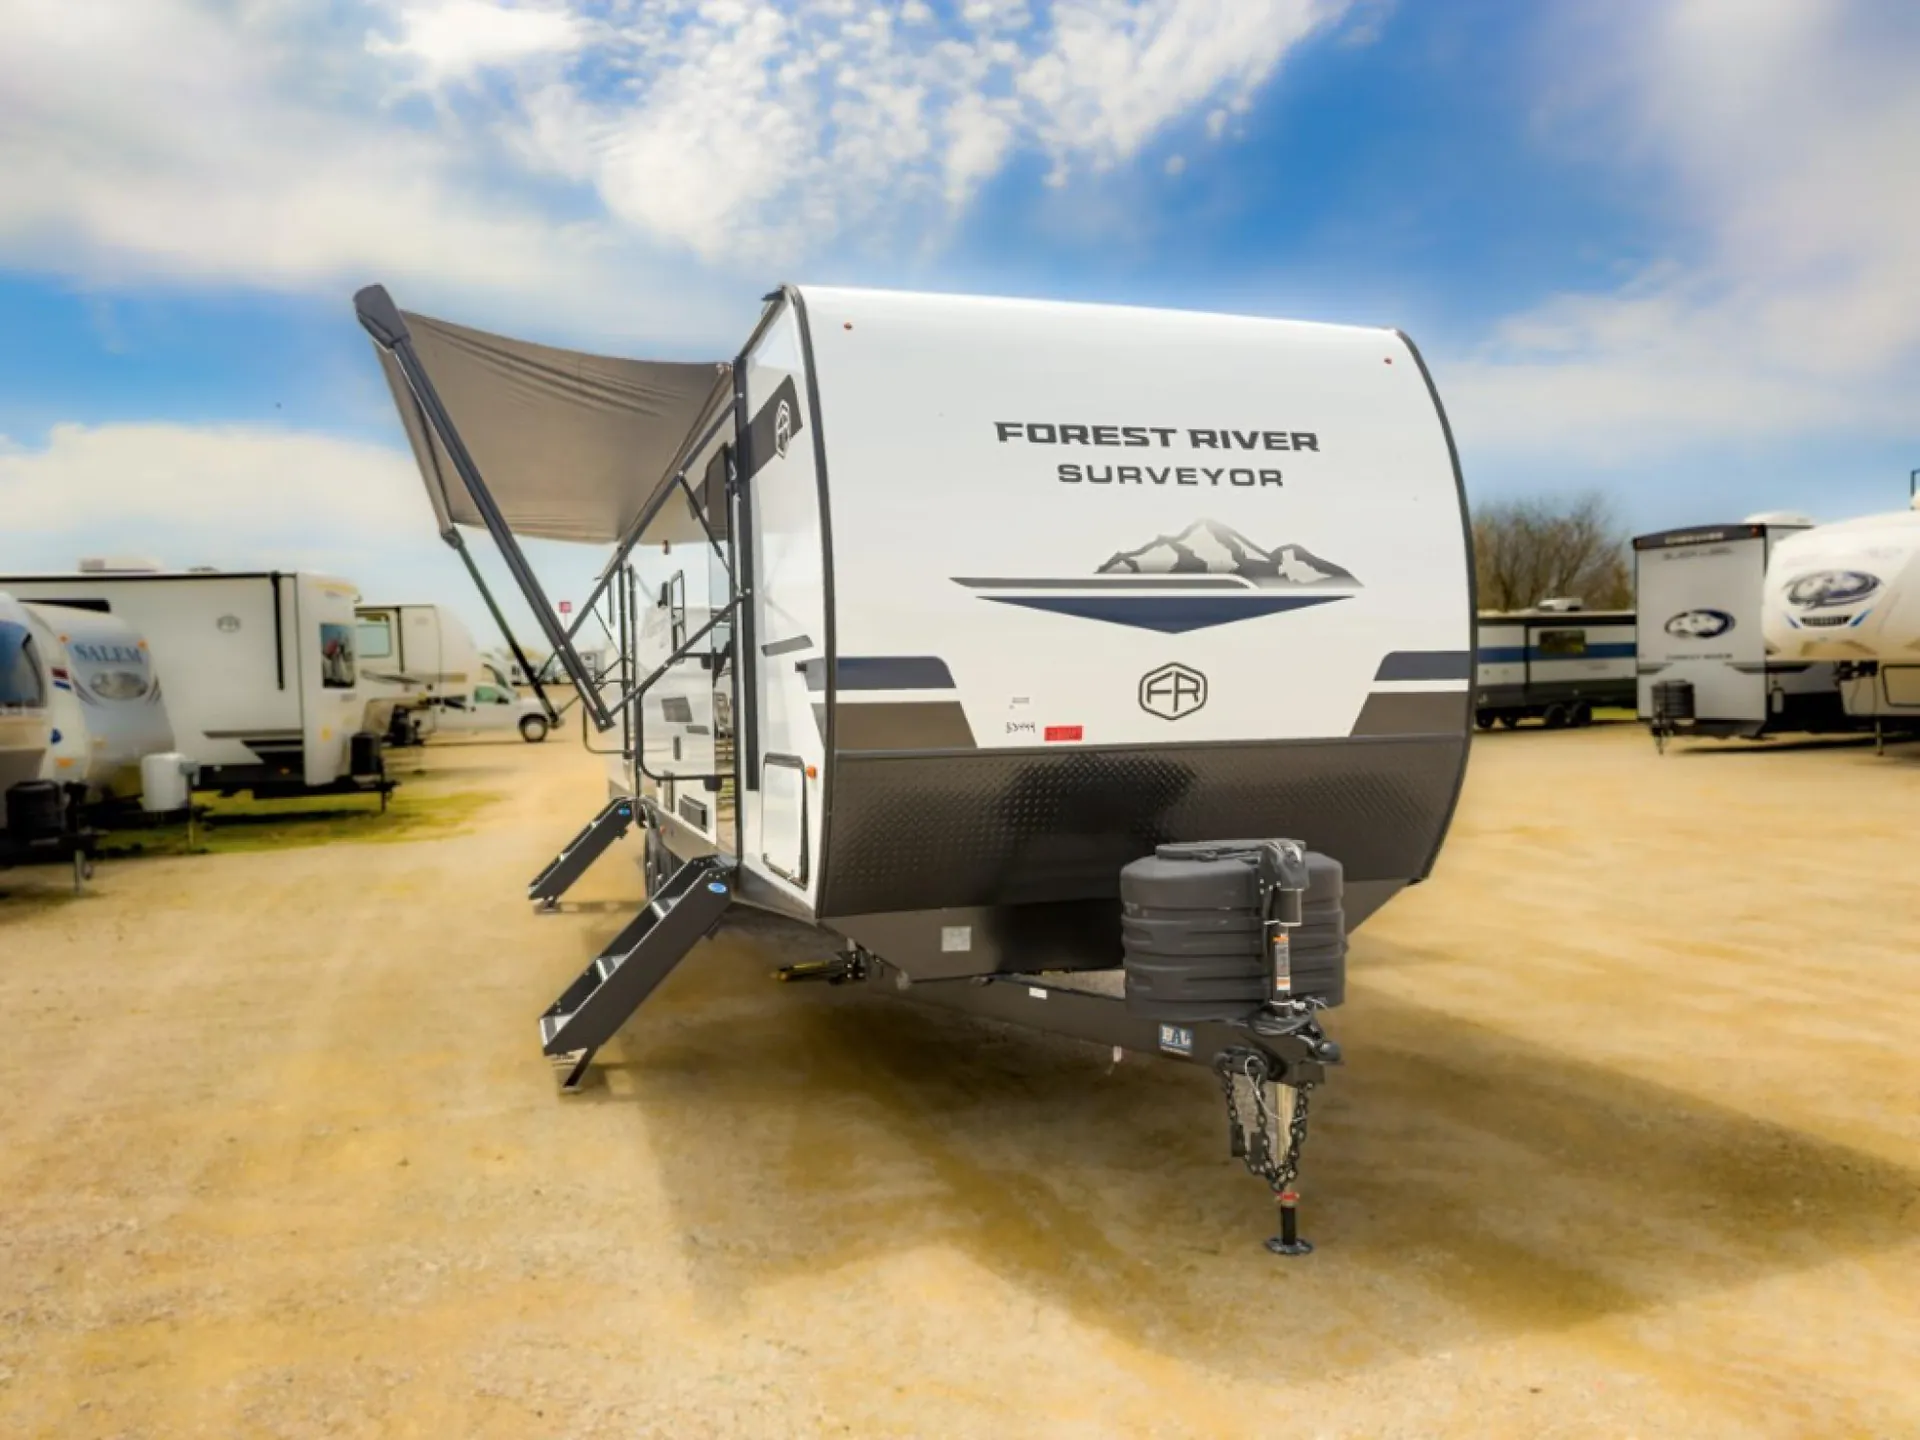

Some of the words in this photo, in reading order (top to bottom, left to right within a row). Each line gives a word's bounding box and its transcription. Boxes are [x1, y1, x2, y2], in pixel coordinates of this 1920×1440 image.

[994, 421, 1177, 448] FOREST
[1187, 428, 1321, 452] RIVER
[1057, 463, 1283, 487] SURVEYOR
[73, 643, 142, 664] SALEM
